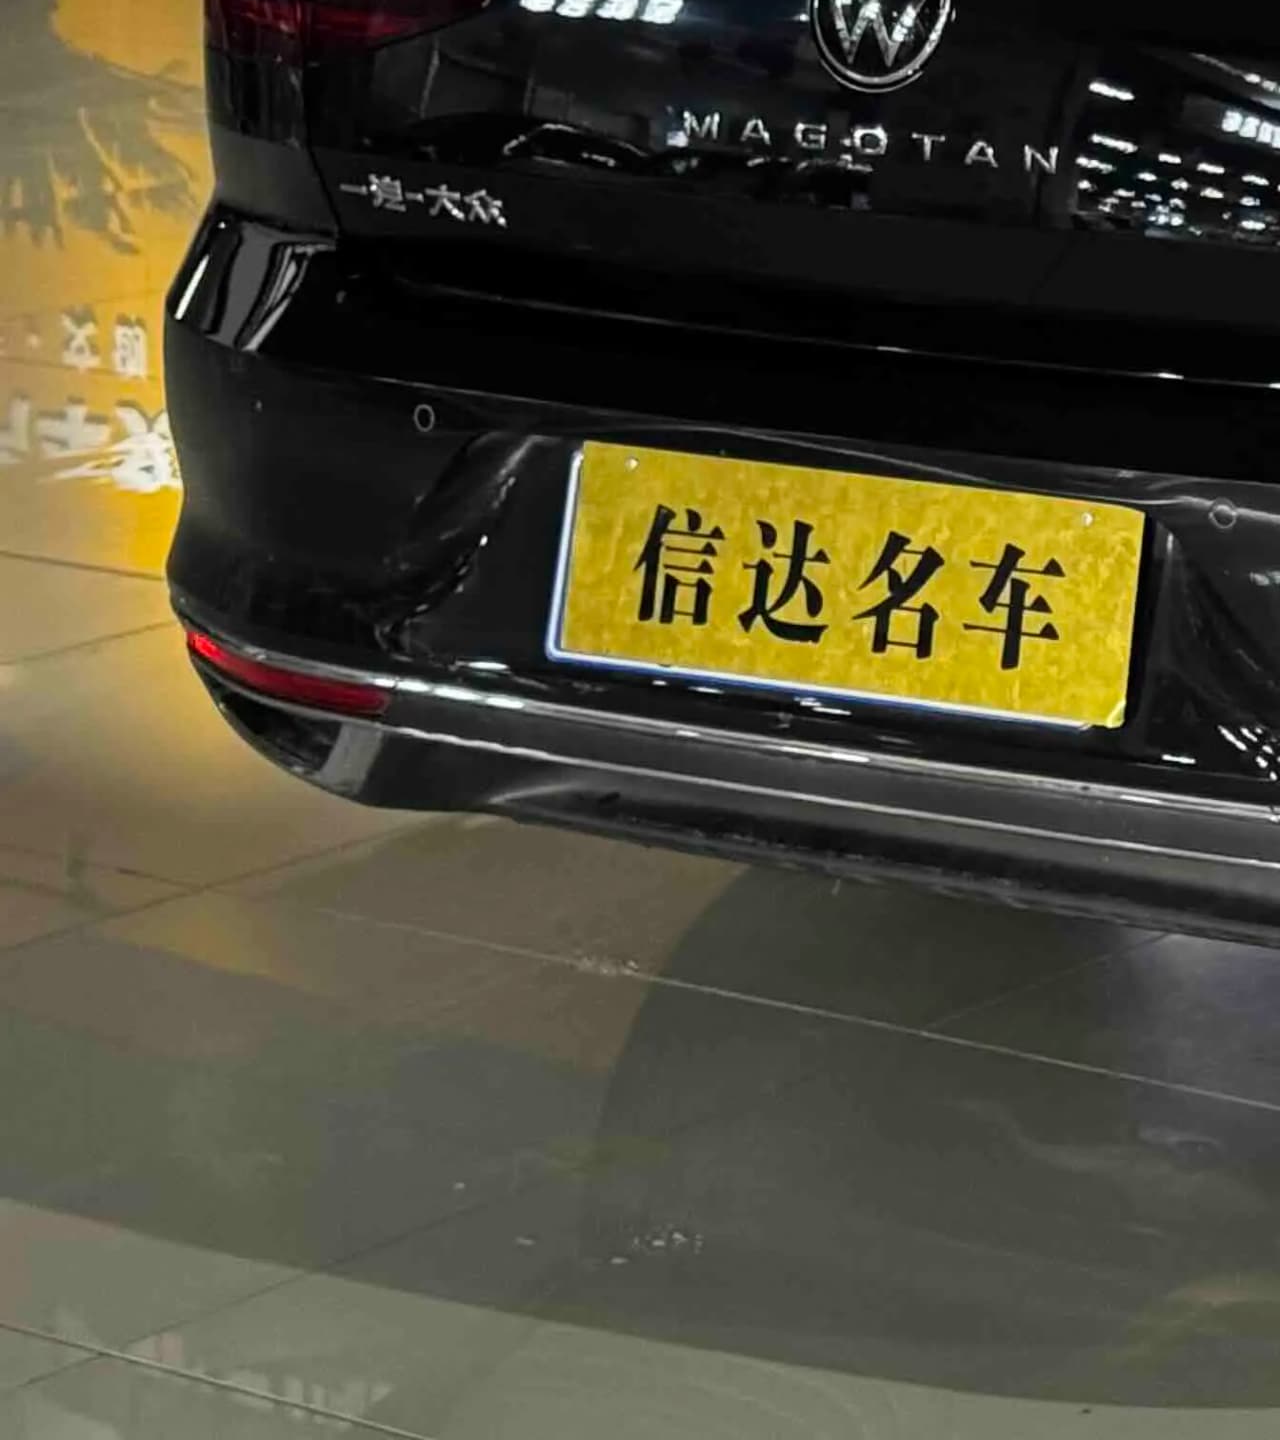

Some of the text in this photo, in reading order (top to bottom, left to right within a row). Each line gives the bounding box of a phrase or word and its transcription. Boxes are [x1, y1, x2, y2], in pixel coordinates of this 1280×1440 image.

[682, 110, 1060, 174] MAGOTAN
[634, 503, 1066, 671] 信达名车
